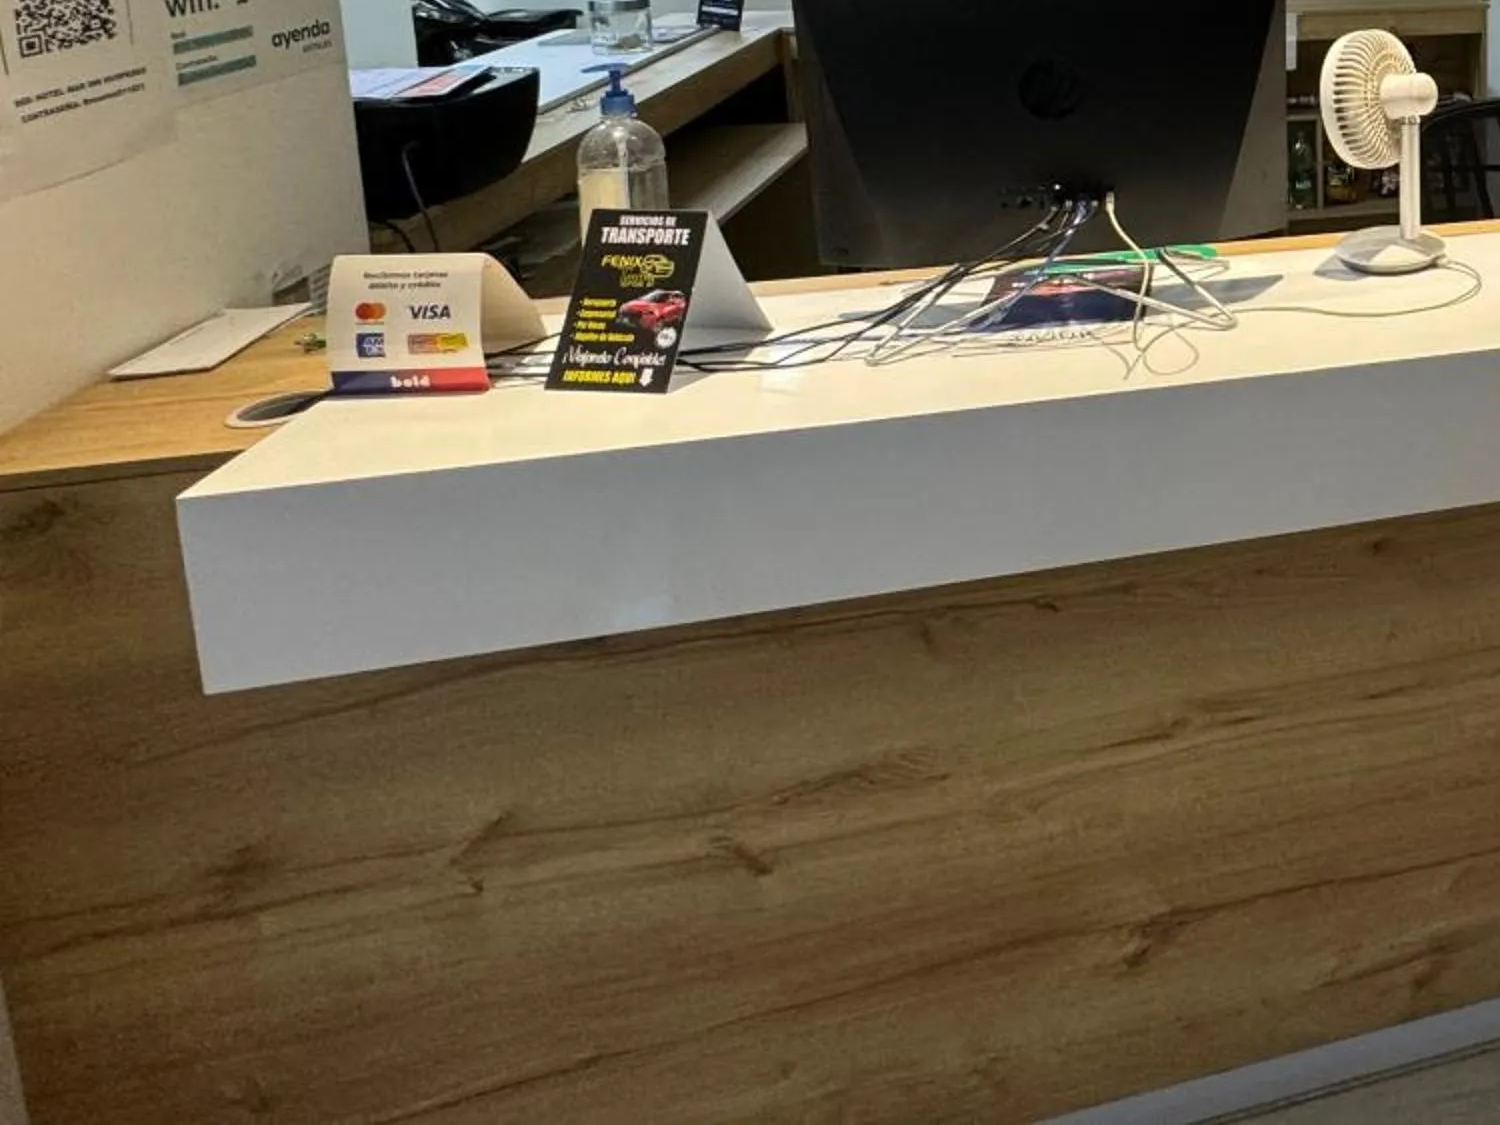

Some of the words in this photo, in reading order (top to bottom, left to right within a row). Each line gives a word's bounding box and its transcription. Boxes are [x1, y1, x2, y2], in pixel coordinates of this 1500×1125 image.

[271, 19, 331, 50] ayenda
[600, 226, 692, 246] TRANSPORTE
[409, 304, 452, 321] VISA
